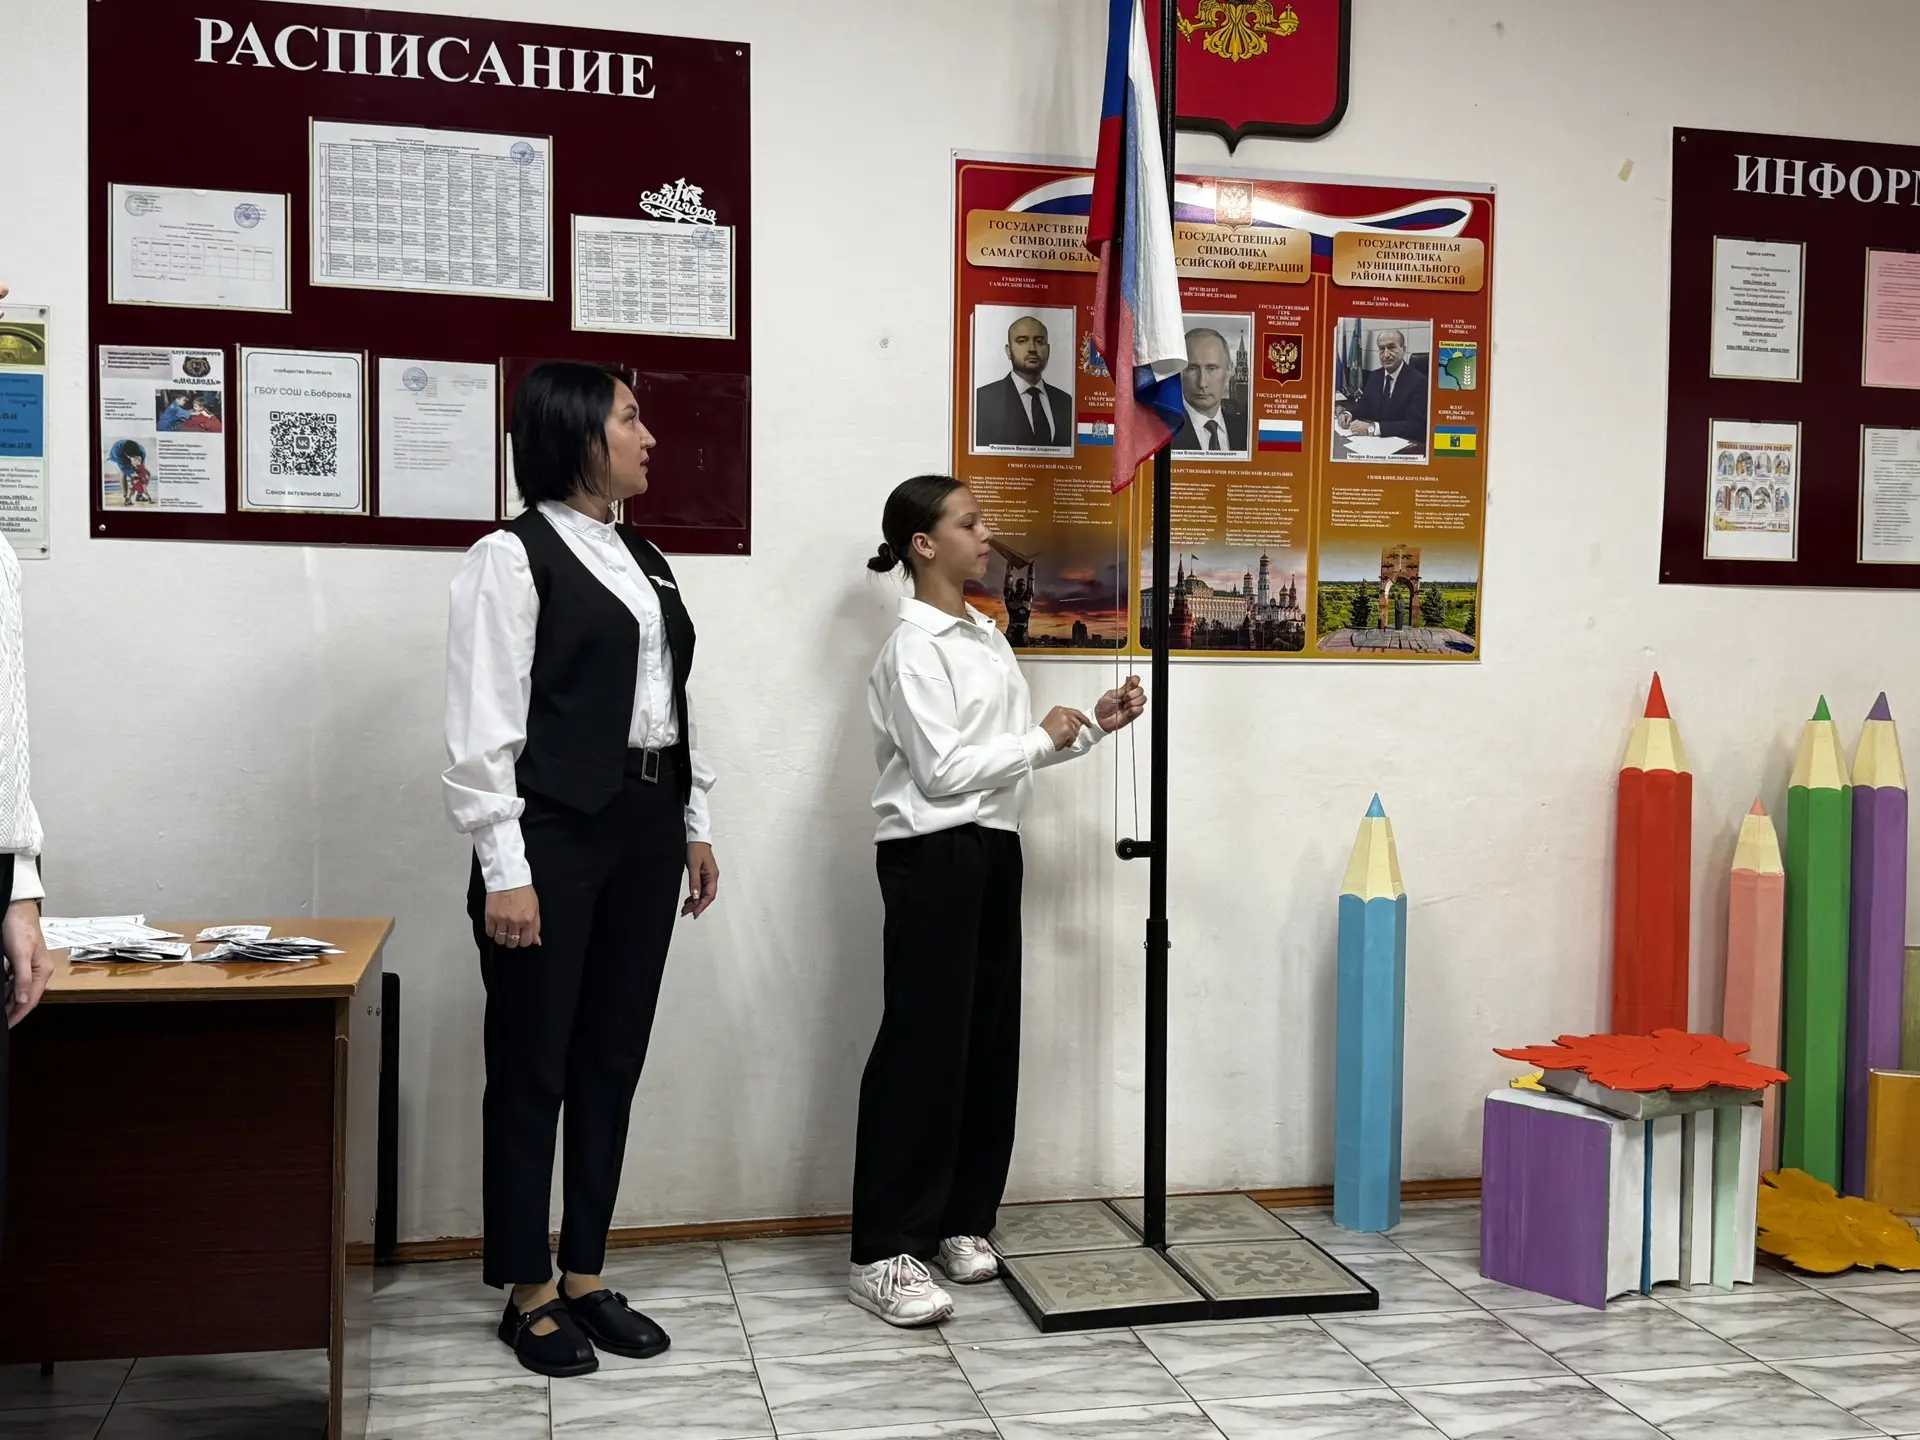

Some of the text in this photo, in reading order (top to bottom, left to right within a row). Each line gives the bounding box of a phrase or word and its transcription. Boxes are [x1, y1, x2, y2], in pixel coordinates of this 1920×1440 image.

[194, 17, 656, 99] РАСПИСАНИЕ
[989, 220, 1088, 235] ГОСУДАРСТВЕН
[1010, 235, 1086, 248] СИМВОЛИКА
[1179, 231, 1287, 246] ГОСУДАРСТВЕННАЯ
[1358, 238, 1461, 252] ГОСУДАРСТВЕННАЯ
[981, 247, 1099, 263] САМАРСКОЙ ОБЛАС
[1197, 245, 1267, 258] СИМВОЛИКА
[1376, 251, 1442, 262] СИМВОЛИКА
[1175, 256, 1304, 274] ССИЙСКОЙ ФЕДЕРАЦИИ
[1357, 261, 1461, 274] МУНИЦИПАЛЬНОГО
[1350, 270, 1466, 285] РАЙОНА КИНЕЛЬСКИЙ
[173, 378, 221, 386] «МЕДВЕДЬ»
[254, 386, 352, 399] ГБОУ СОШ с.Бобровка
[287, 490, 321, 498] актуальное
